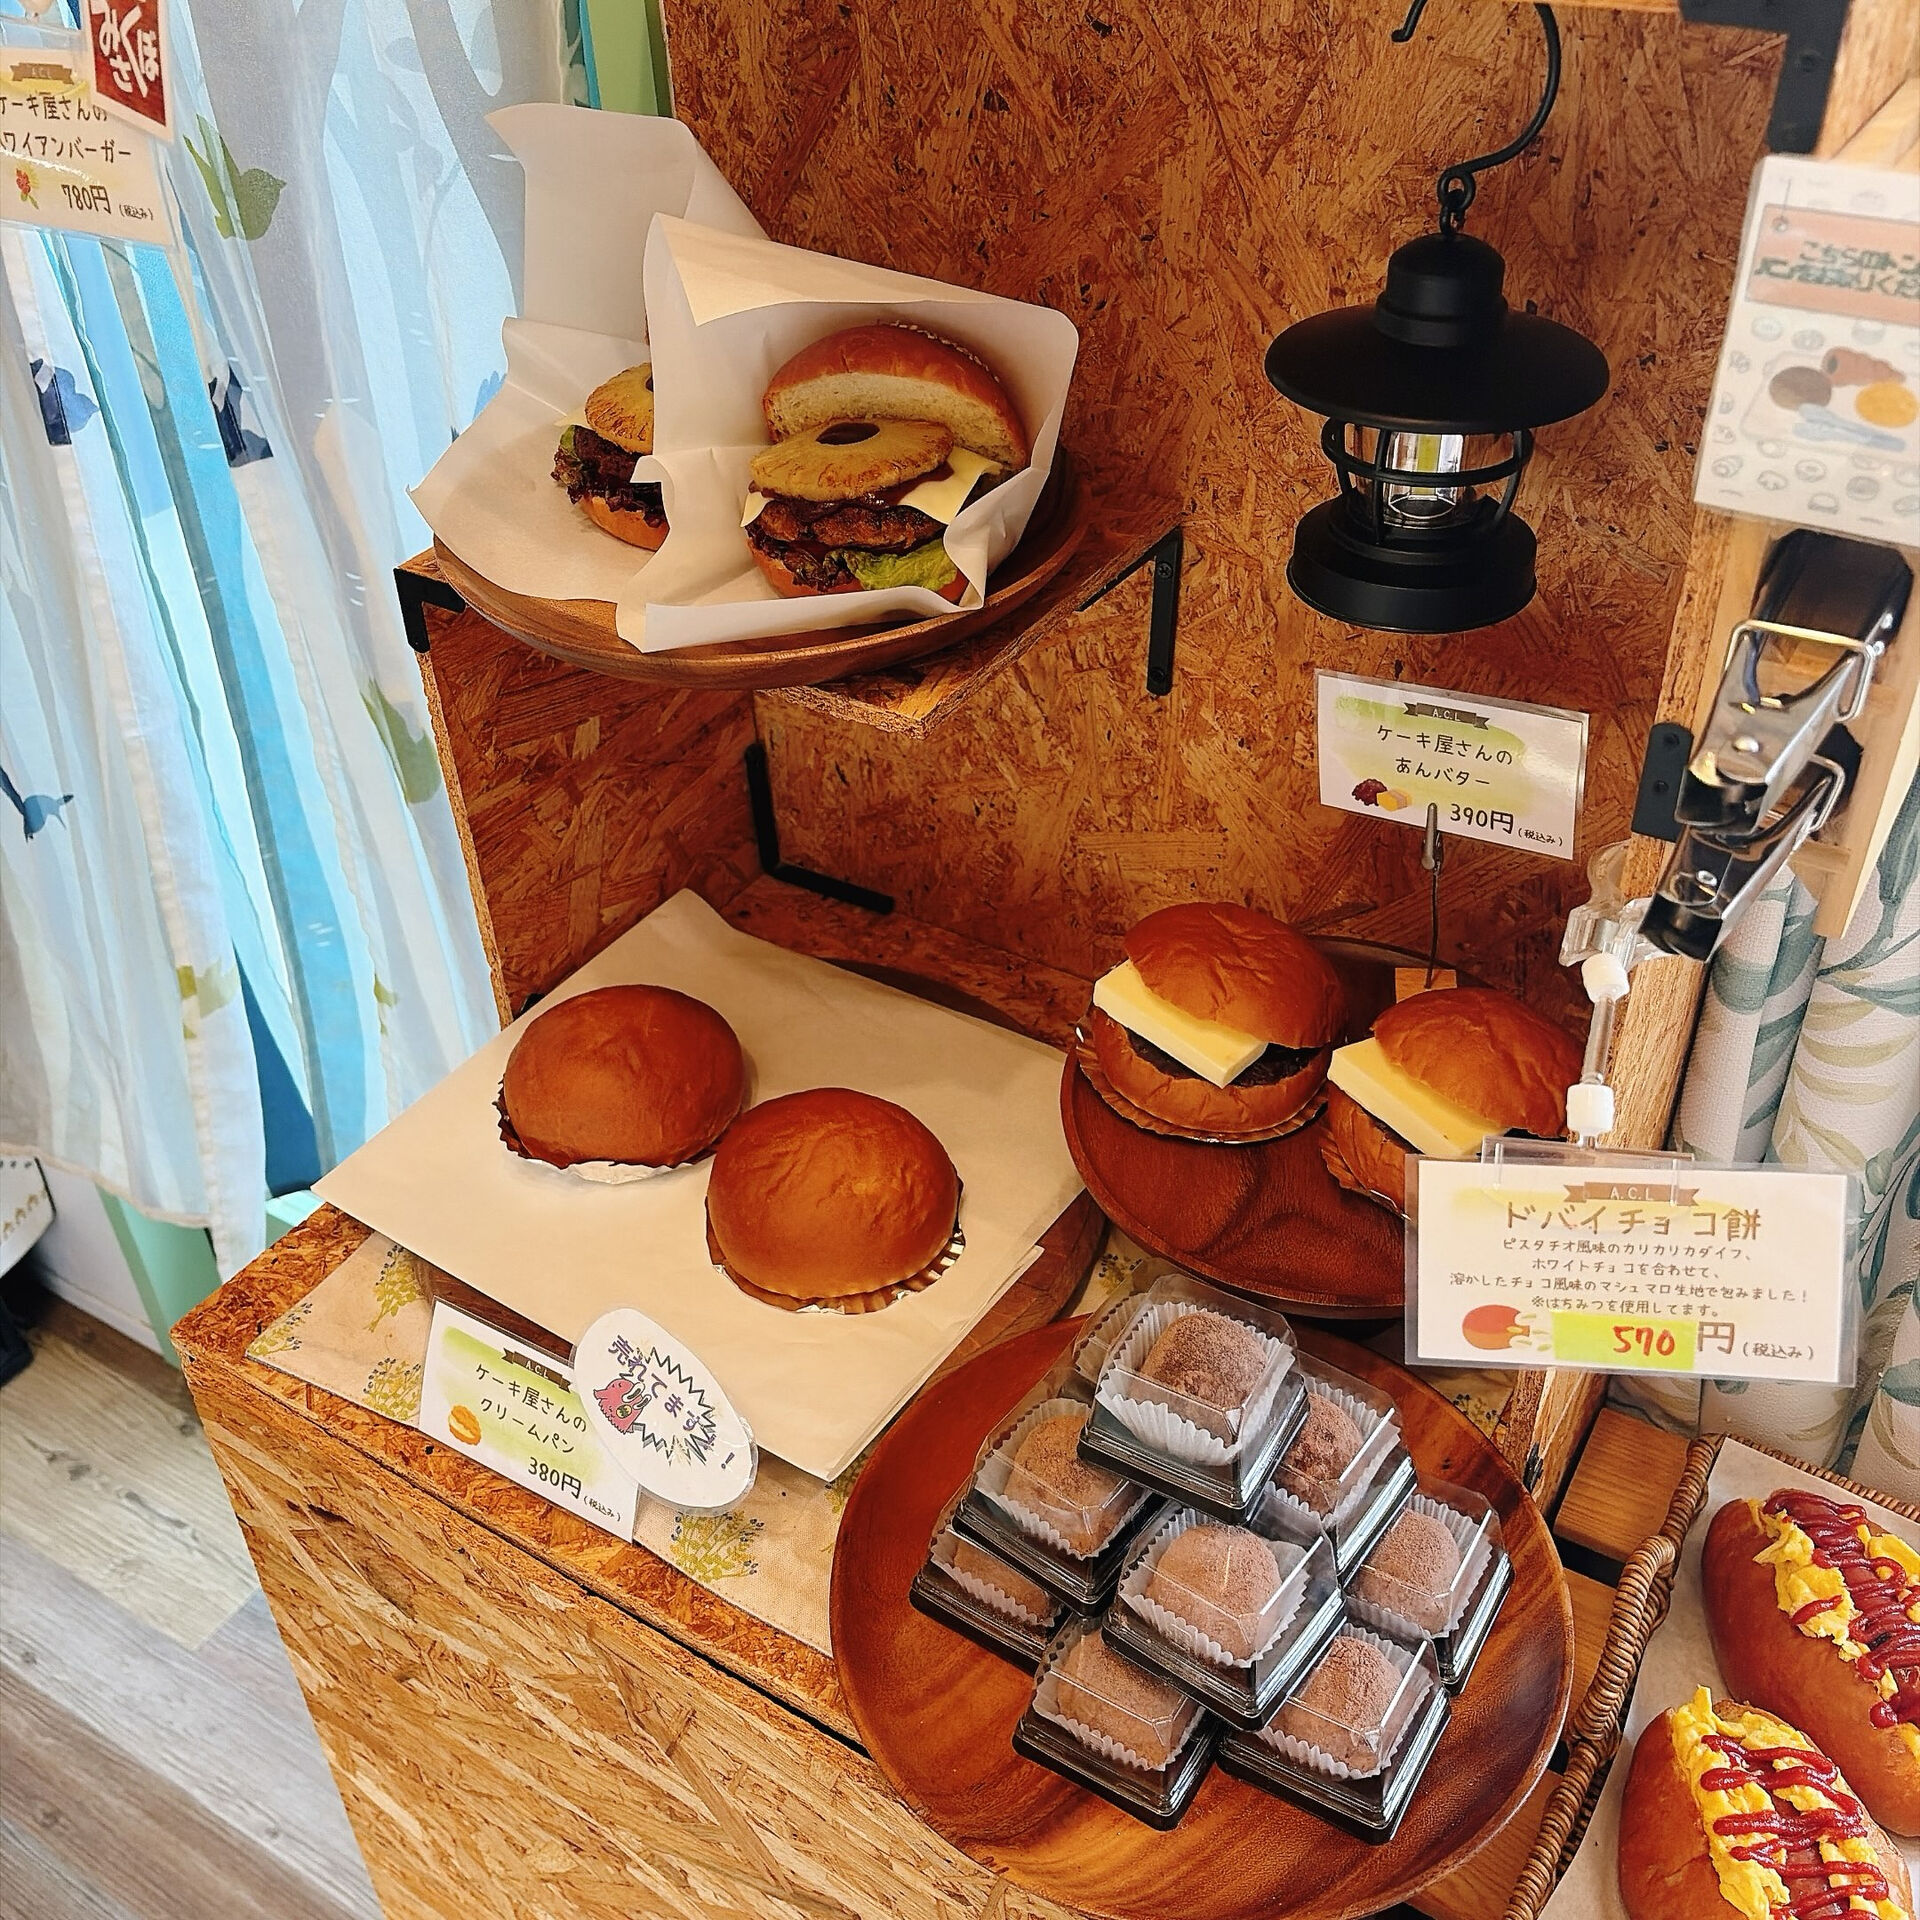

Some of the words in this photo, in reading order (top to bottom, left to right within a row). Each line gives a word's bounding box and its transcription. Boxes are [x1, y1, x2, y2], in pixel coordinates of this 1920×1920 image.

[61, 184, 112, 214] 780円
[1377, 725, 1512, 766] ケーキ屋さんの
[1395, 757, 1490, 786] あんバター
[1450, 803, 1514, 834] 390円
[1518, 827, 1563, 847] (税込み)
[1508, 1201, 1761, 1242] ドバイチョコ餅
[1503, 1238, 1751, 1260] ピスタチオ風味のカリカリカダイフ、
[1532, 1258, 1719, 1279] ホワイトチョコを合わせて、
[1742, 1341, 1815, 1361] (税込み)
[476, 1363, 587, 1433] ケーキ屋さんの
[481, 1398, 575, 1454] クリームパン
[528, 1457, 583, 1499] 380円
[584, 1495, 621, 1522] (税込み)
